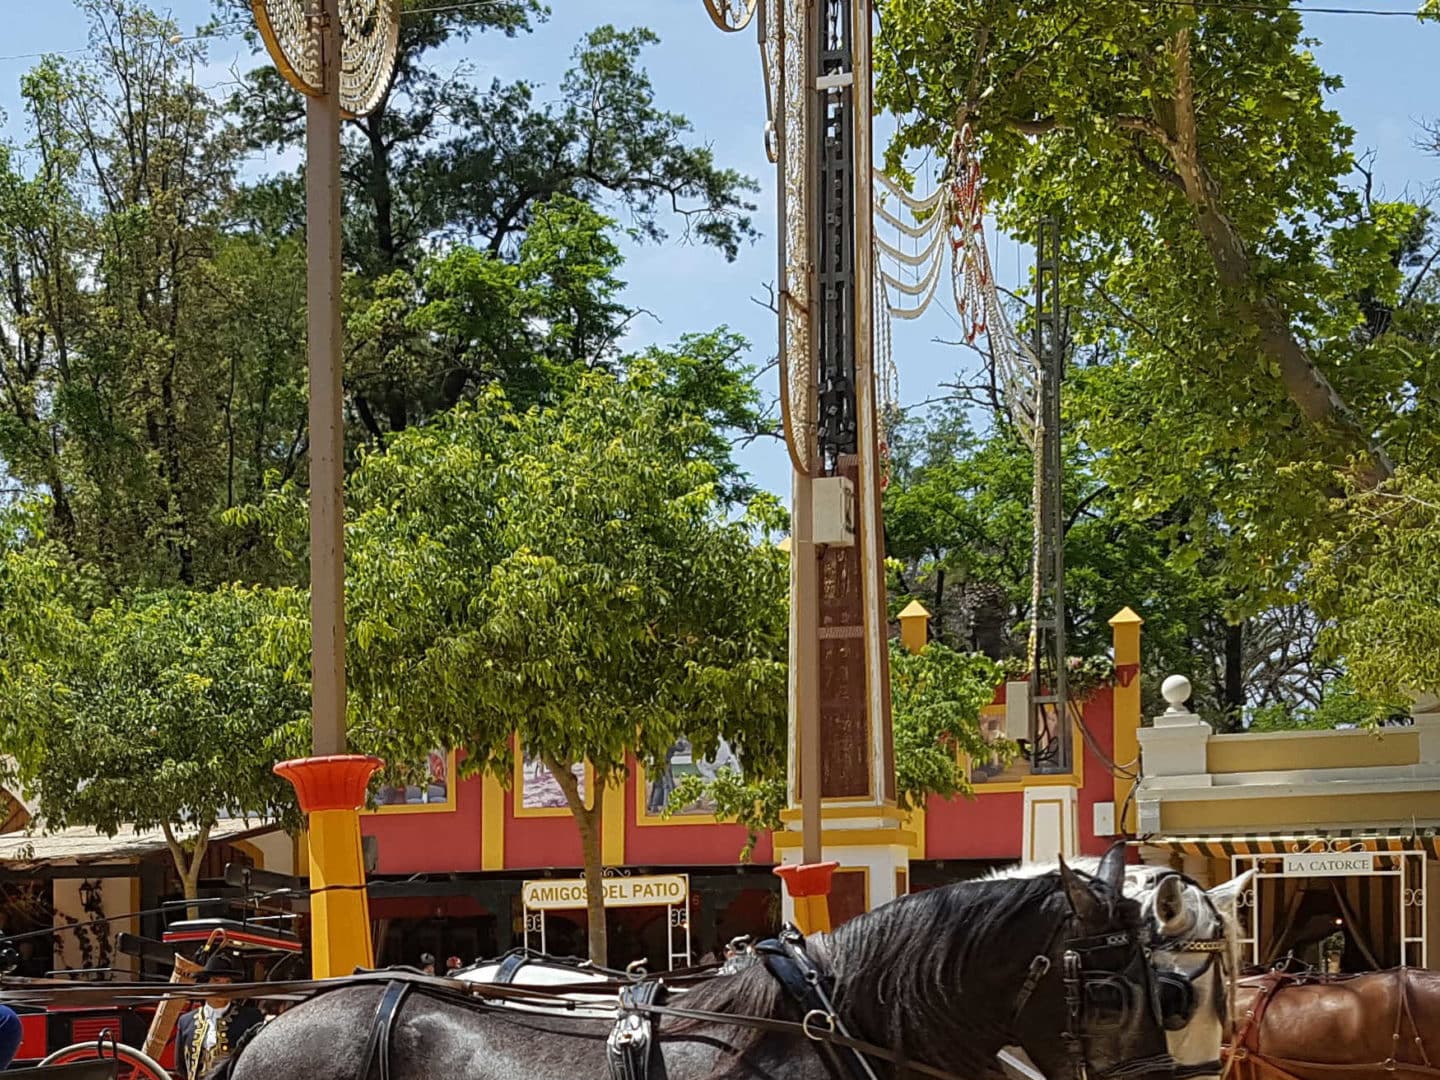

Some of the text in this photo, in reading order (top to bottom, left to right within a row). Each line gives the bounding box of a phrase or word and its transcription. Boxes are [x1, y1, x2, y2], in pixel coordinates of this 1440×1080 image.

[1288, 859, 1370, 872] LA CATORCE
[529, 886, 590, 902] AMIGOS
[632, 882, 681, 898] PATIO
